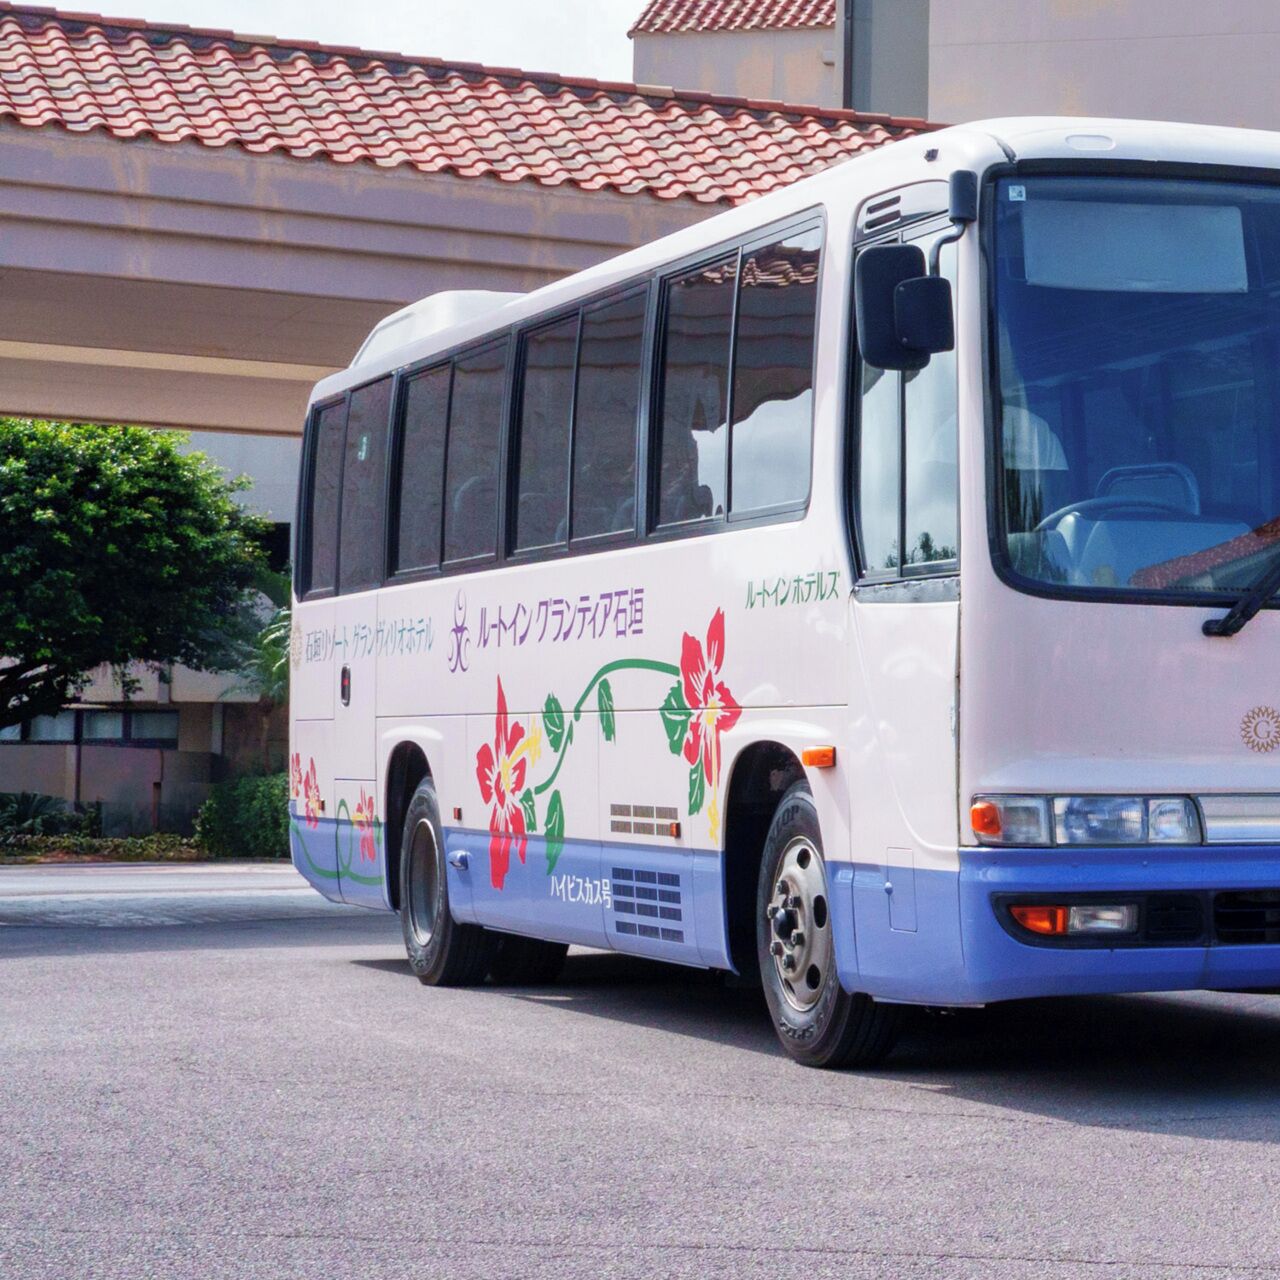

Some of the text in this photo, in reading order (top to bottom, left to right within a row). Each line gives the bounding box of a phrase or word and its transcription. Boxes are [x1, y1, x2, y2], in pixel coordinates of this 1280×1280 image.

[744, 570, 840, 610] ルートインホテルズ
[476, 587, 644, 649] ルートイン グランティア石垣
[550, 874, 611, 909] ハイビスカス号
